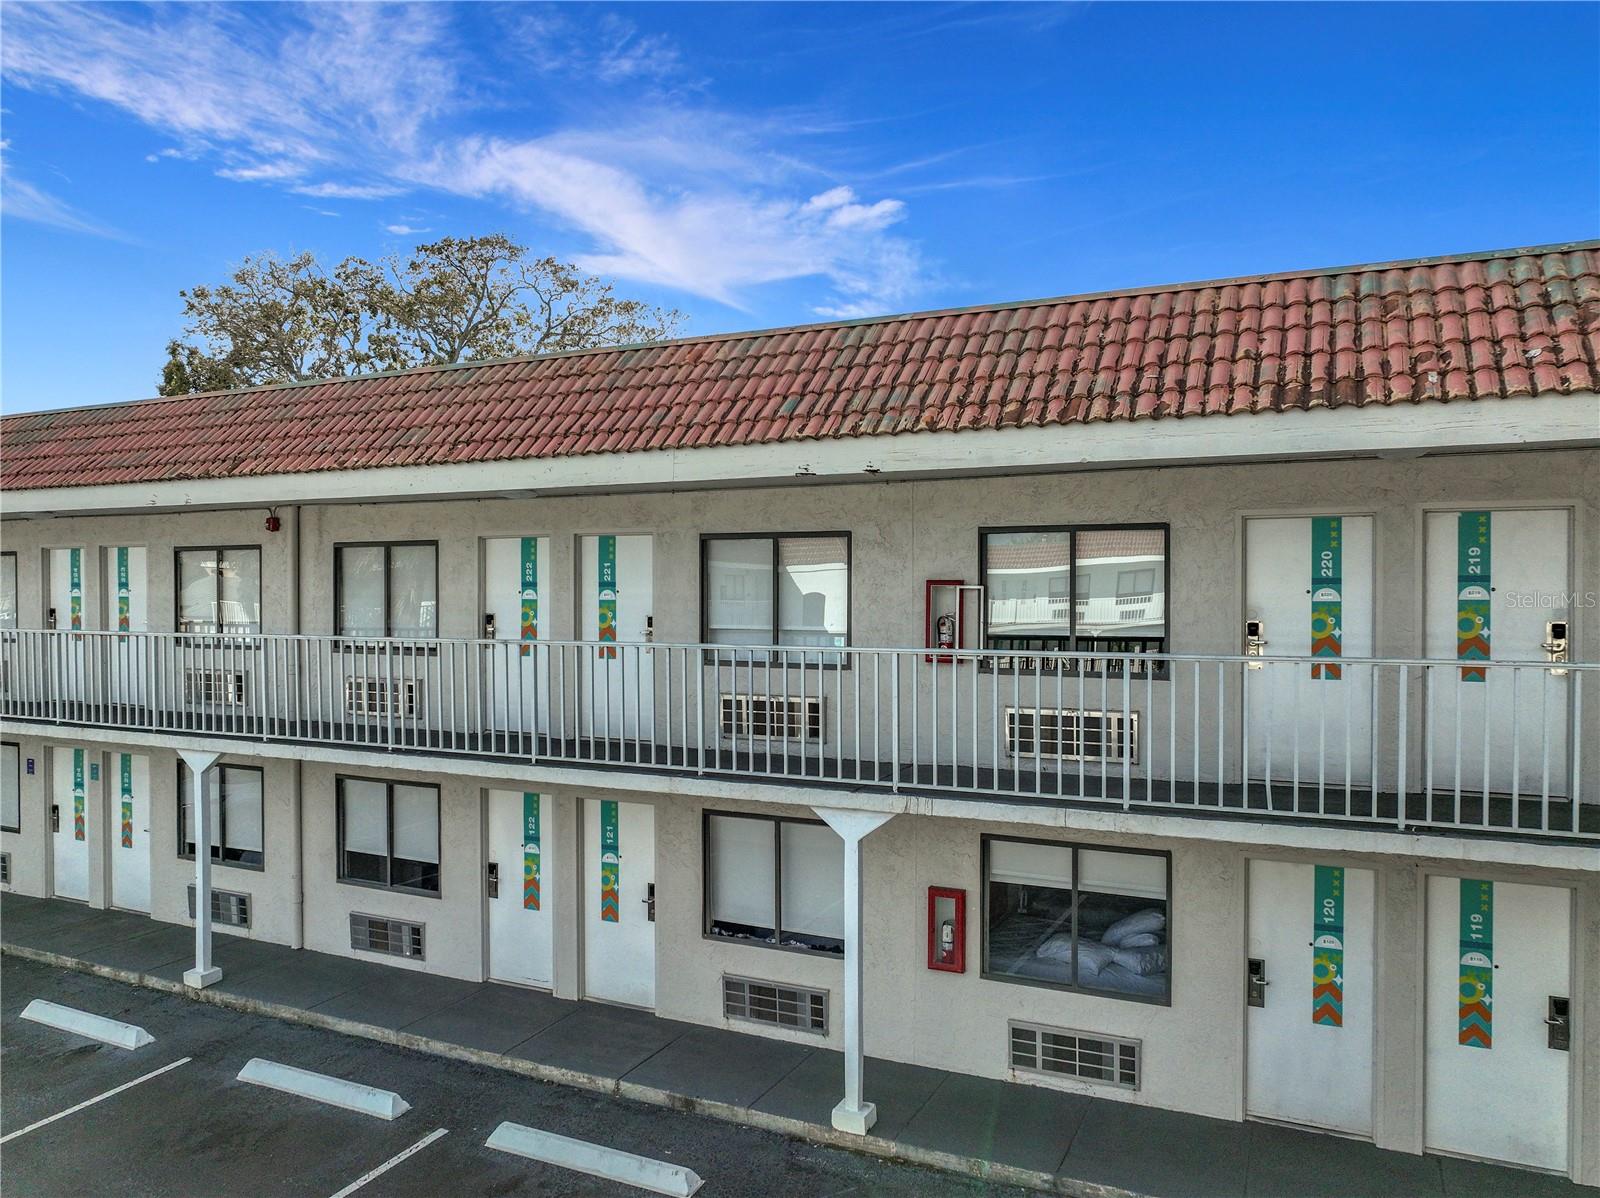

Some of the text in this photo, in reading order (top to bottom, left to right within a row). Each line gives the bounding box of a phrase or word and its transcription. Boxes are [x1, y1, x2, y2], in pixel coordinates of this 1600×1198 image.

[603, 562, 611, 582] 221
[1321, 551, 1333, 577] 220
[1468, 547, 1481, 574] 219
[528, 816, 536, 835] 122
[606, 825, 614, 844] 121
[1323, 898, 1335, 924] 120
[1470, 913, 1483, 939] 119
